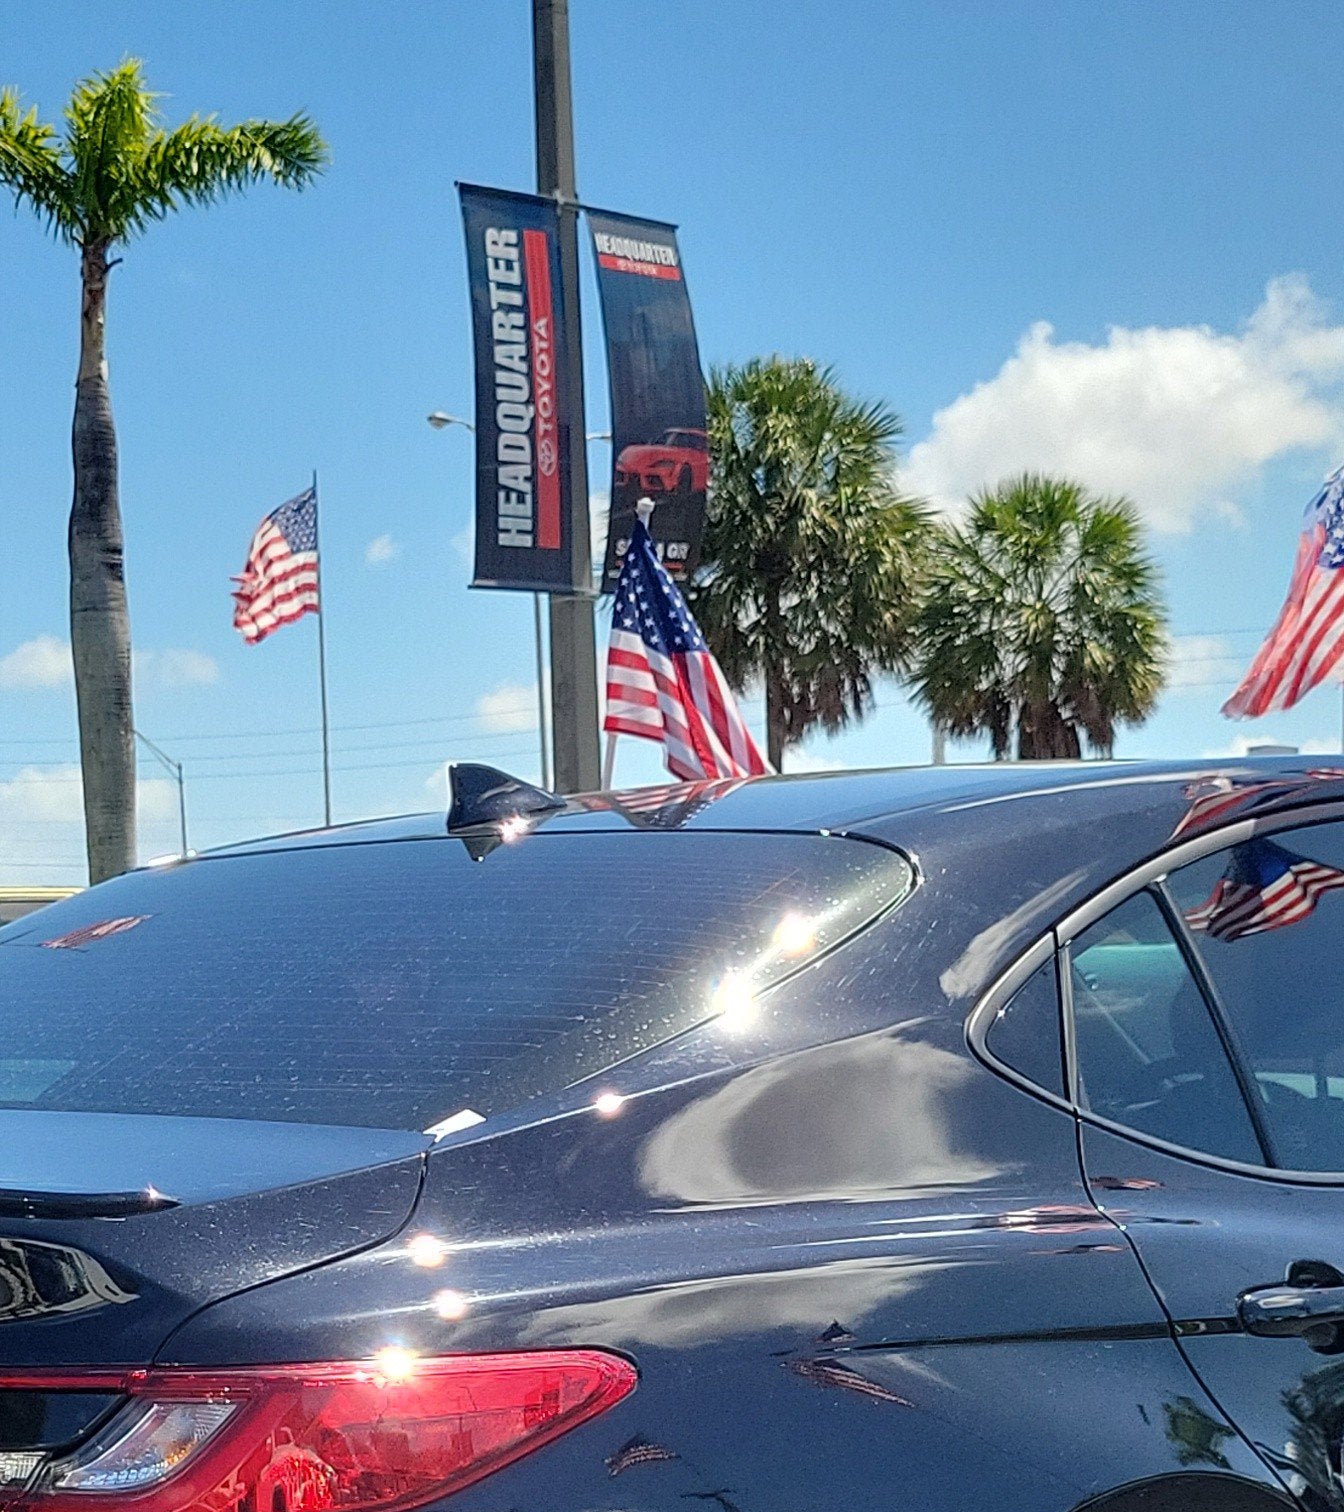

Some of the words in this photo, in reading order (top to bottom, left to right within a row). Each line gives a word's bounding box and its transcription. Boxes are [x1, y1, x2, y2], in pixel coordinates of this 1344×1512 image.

[594, 233, 677, 267] HEADQUARTER
[485, 227, 535, 549] HEADQUARTER
[531, 317, 556, 433] TOYOTA
